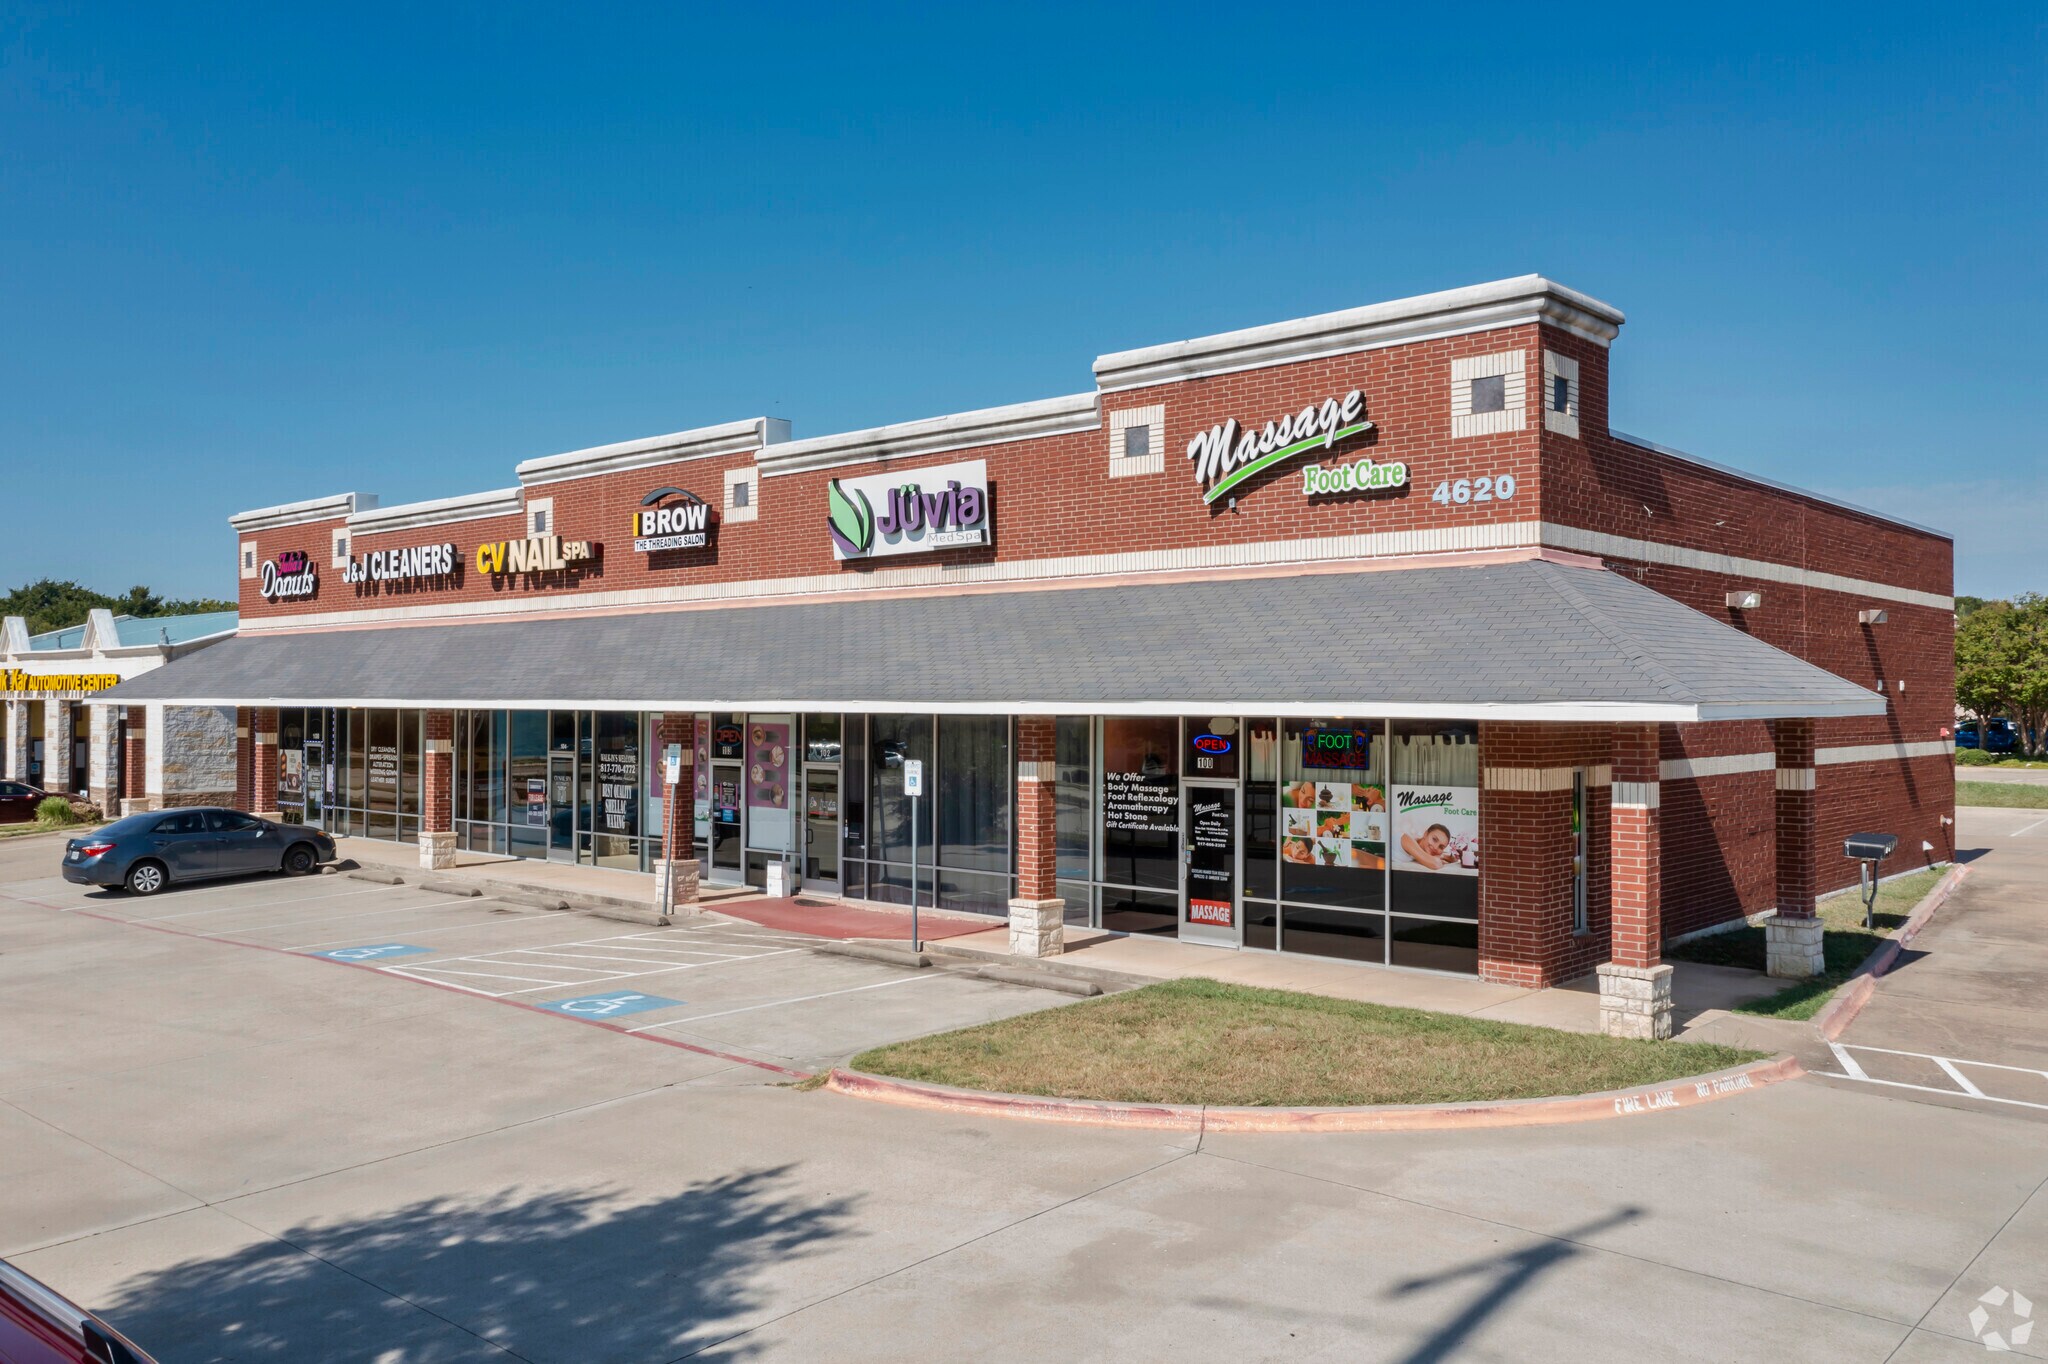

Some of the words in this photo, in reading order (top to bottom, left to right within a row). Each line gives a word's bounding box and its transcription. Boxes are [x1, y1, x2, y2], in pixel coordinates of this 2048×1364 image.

[1187, 390, 1362, 483] Massage
[1304, 466, 1351, 492] Foot
[1354, 460, 1405, 487] Care
[1432, 475, 1516, 505] 4620
[877, 480, 980, 534] Jüvia
[636, 541, 647, 550] THE
[648, 537, 683, 549] THREADING
[684, 534, 704, 546] SALON
[928, 532, 954, 543] Med
[957, 531, 982, 543] Spa
[476, 542, 505, 574] CV
[508, 535, 566, 573] NAIL
[562, 541, 590, 561] SPA
[277, 552, 303, 577] Julia's
[342, 553, 368, 584] J&J
[370, 543, 453, 580] CLEANERS
[260, 560, 315, 598] Donuts
[11, 668, 28, 691] Kar
[29, 674, 81, 691] AUTOMOTIVE
[81, 674, 117, 691] CENTER
[714, 729, 742, 742] OPEN
[1317, 734, 1353, 749] FOOT
[1196, 738, 1227, 750] OPEN
[819, 749, 831, 757] 102
[1305, 751, 1366, 768] MASSAGE
[600, 763, 636, 774] 817-770-4772
[1197, 757, 1214, 769] 100
[1107, 772, 1121, 781] We
[1122, 772, 1146, 782] Offer
[1107, 782, 1129, 793] Body
[1131, 783, 1169, 794] Massage
[1107, 792, 1126, 801] Foot
[1127, 793, 1179, 805] Reflexology
[1396, 789, 1453, 808] Massage
[1107, 802, 1169, 814] Aromatherapy
[1444, 807, 1460, 816] Foot
[1461, 807, 1477, 817] Care
[1107, 811, 1123, 819] Hot
[1124, 812, 1148, 821] Stone
[1106, 820, 1117, 828] Gift
[1118, 821, 1149, 830] Certificate
[1149, 823, 1180, 832] Available
[1191, 904, 1230, 923] MASSAGE
[1614, 1095, 1645, 1115] FIRE
[1645, 1090, 1680, 1110] LANE
[1694, 1081, 1710, 1098] NO
[1711, 1072, 1754, 1095] PARKING
